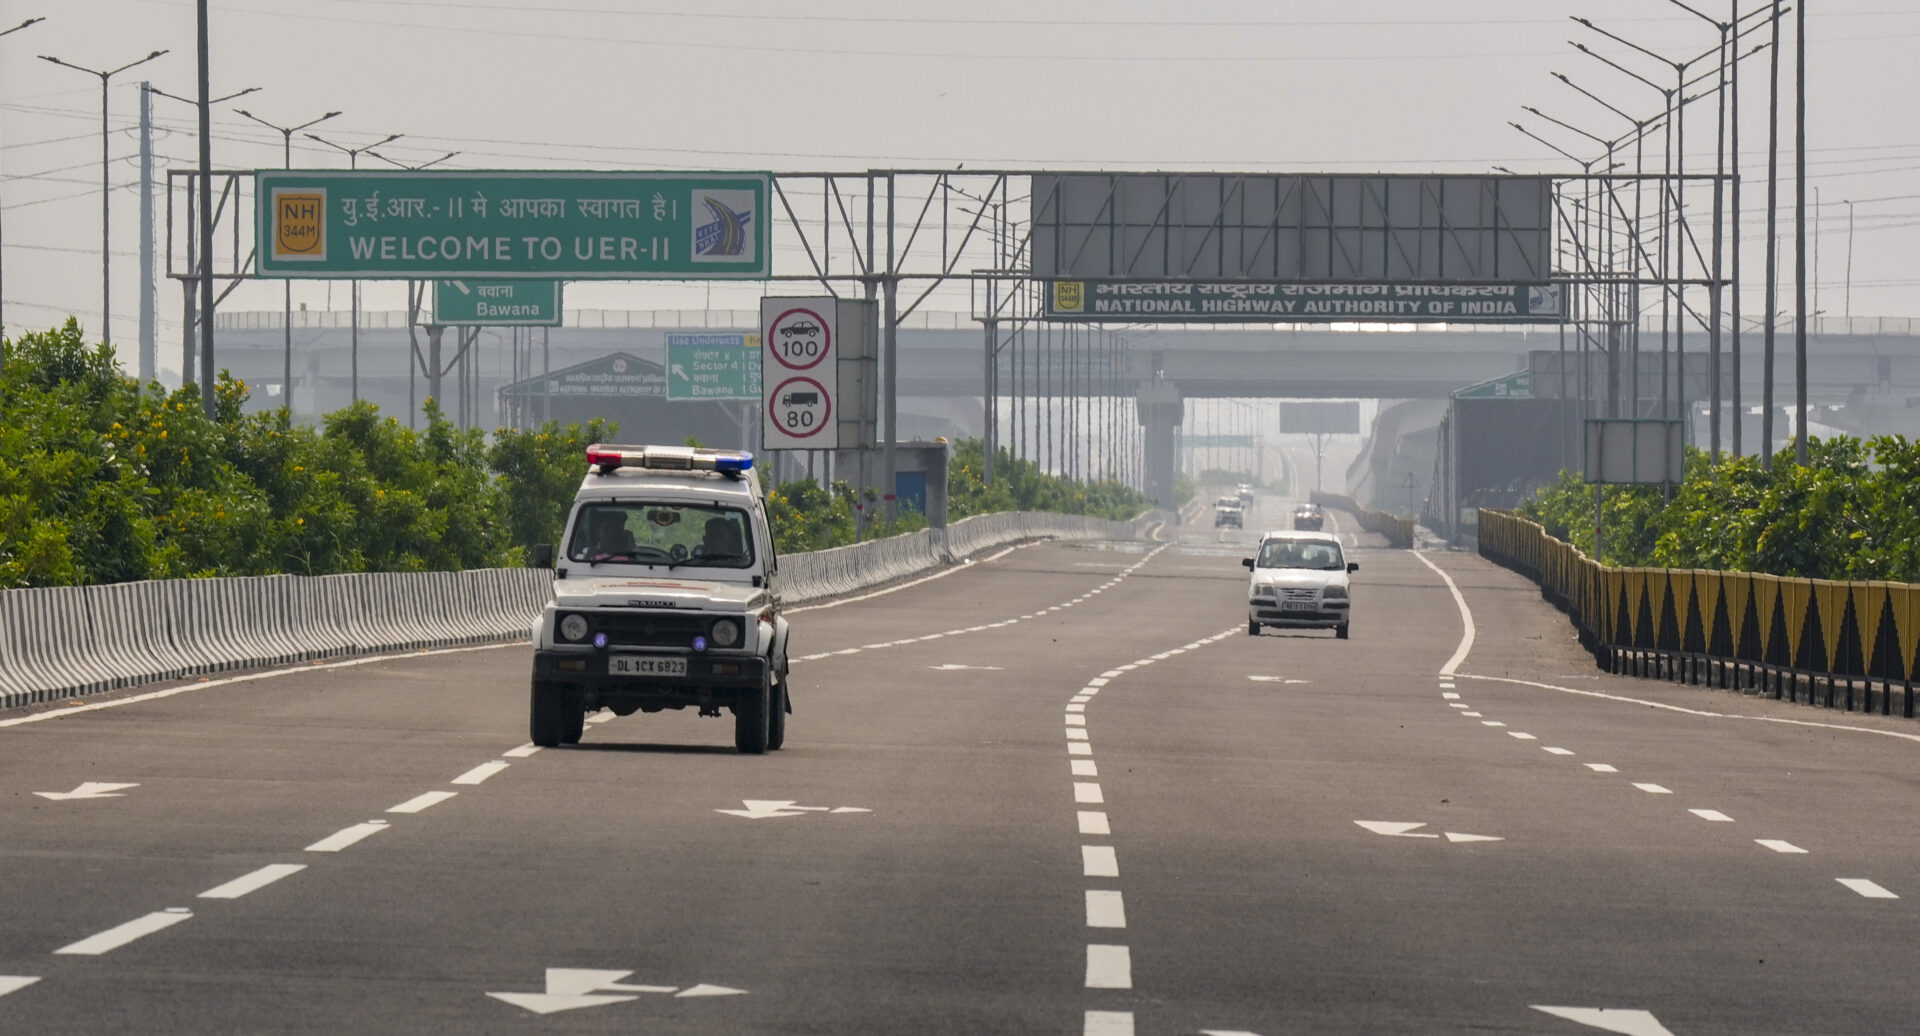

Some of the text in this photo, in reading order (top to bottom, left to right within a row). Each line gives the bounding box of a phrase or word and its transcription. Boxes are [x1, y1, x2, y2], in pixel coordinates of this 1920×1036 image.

[285, 203, 315, 219] NH
[499, 198, 565, 218] आपका
[576, 198, 640, 218] स्वागत
[284, 225, 316, 238] 344M
[349, 236, 669, 260] WELCOME TO UER-II
[1061, 286, 1077, 294] NH
[477, 302, 540, 316] Bawana
[1095, 299, 1516, 313] NATIONAL HIGHWAY AUTHORITY OF INDIA
[782, 341, 818, 357] 100
[693, 361, 728, 371] Sector
[731, 361, 738, 371] 4
[692, 385, 734, 396] Bawana
[787, 411, 813, 427] 80
[617, 660, 630, 672] DL
[635, 660, 654, 673] 1CX
